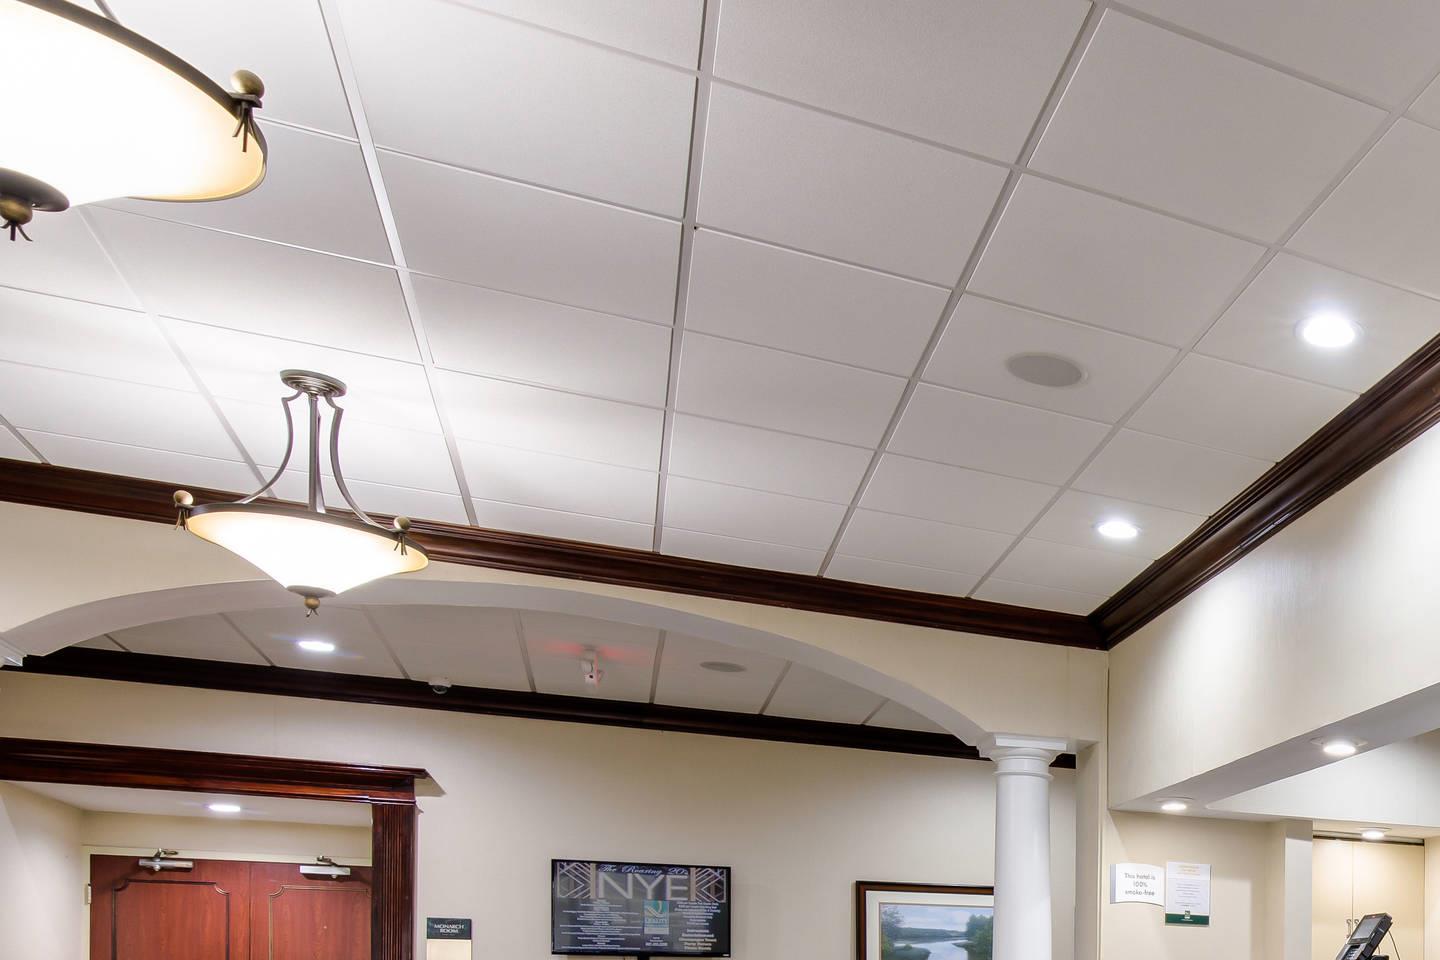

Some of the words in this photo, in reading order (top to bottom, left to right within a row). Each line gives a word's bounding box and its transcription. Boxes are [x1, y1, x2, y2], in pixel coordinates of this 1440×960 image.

[598, 864, 617, 873] The
[1124, 872, 1136, 880] This
[598, 872, 689, 901] NYE
